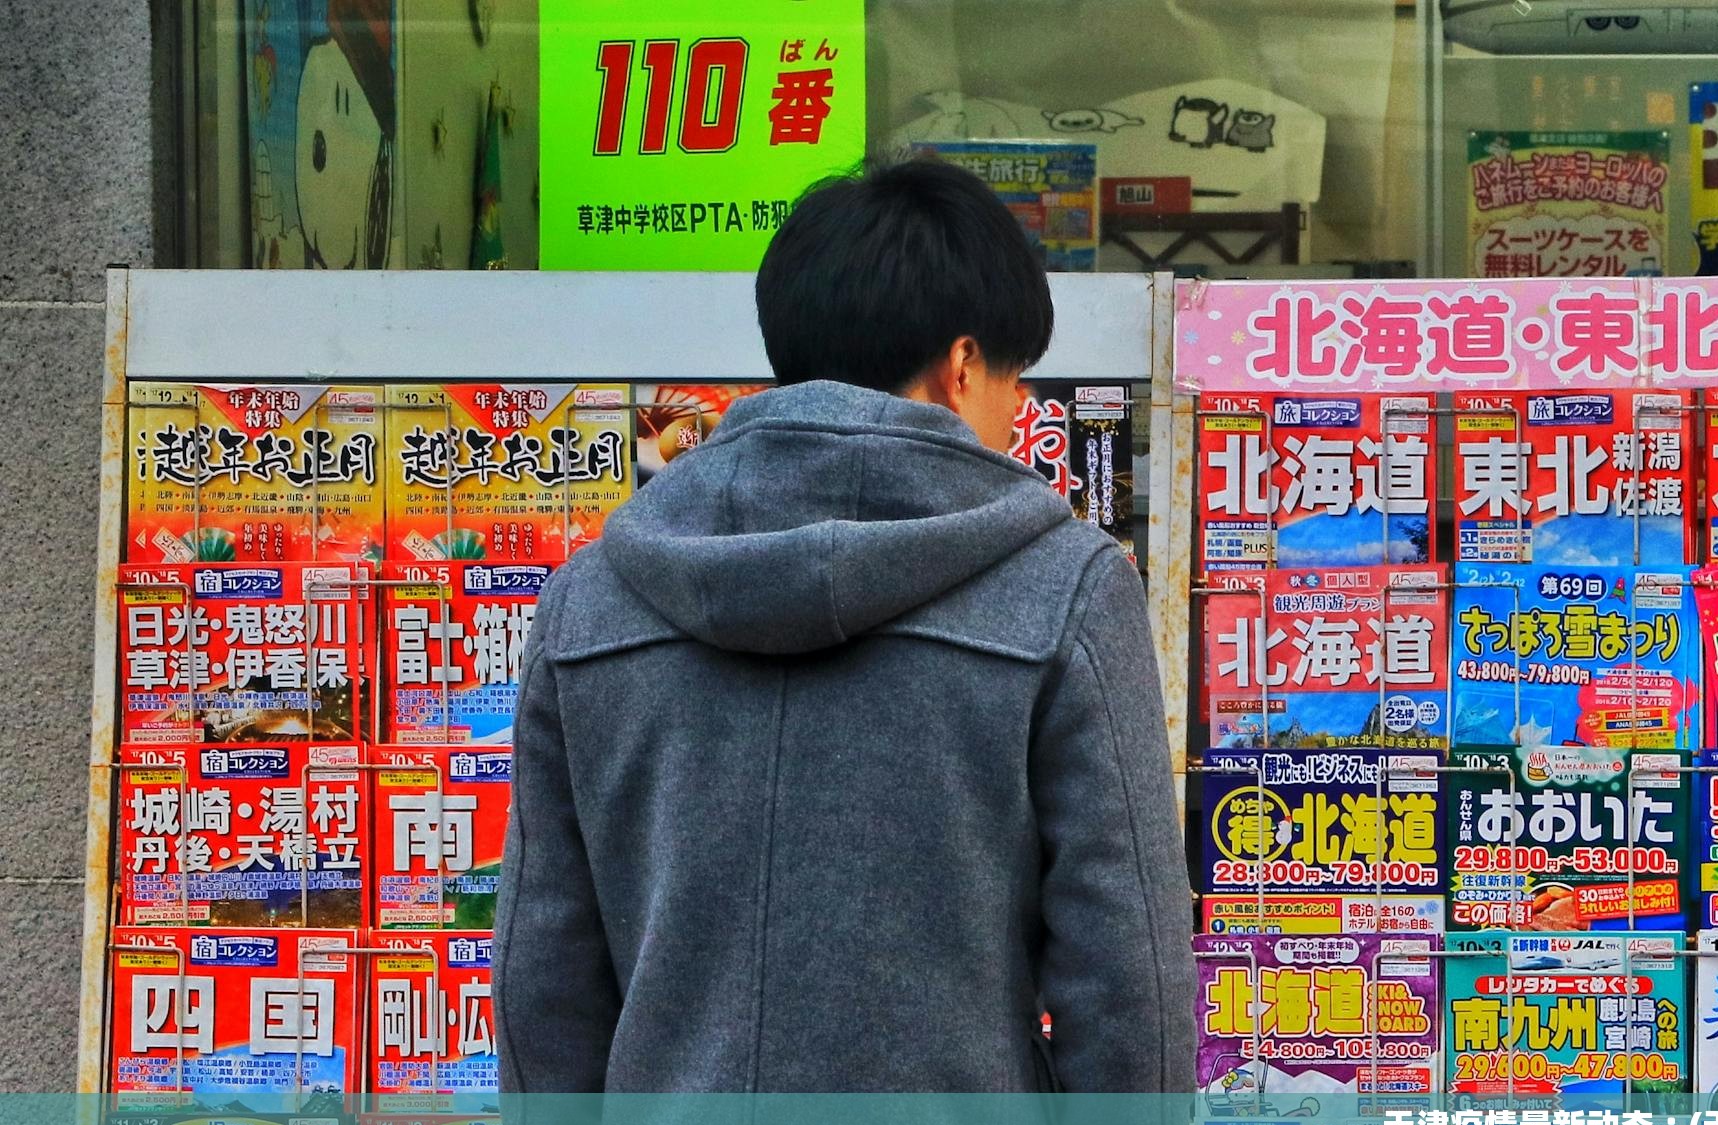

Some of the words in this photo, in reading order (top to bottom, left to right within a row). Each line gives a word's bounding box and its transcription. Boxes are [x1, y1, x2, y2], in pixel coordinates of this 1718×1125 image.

[779, 38, 838, 63] ばん
[592, 35, 750, 156] 110
[768, 67, 834, 147] 番
[577, 202, 797, 236] 草津中学校区PTA・防犯
[1486, 229, 1648, 250] スーツケースを
[229, 391, 300, 409] 年末年始
[245, 409, 281, 428] 特集
[153, 427, 375, 486] 越年お正月
[400, 427, 623, 487] 越年お正月
[1206, 435, 1429, 516] 北海道
[1459, 435, 1610, 516] 東北
[1540, 575, 1605, 598] 第69回
[127, 603, 347, 647] 日光・鬼怒川
[1217, 615, 1436, 687] 北海道
[1460, 603, 1680, 662] さっぽろ雪まつり
[127, 648, 348, 691] 草津・伊香保
[131, 786, 360, 836] 城崎・湯村
[389, 792, 477, 871] 南
[1292, 792, 1437, 864] 北海道
[1459, 789, 1473, 842] おんせん県
[1479, 788, 1675, 844] おおいた
[131, 834, 360, 874] 丹後・天橋立
[1280, 939, 1354, 952] 初すべり・年末年始
[131, 976, 335, 1057] 四国
[1207, 966, 1366, 1035] 北海道
[1453, 998, 1597, 1051] 南九州
